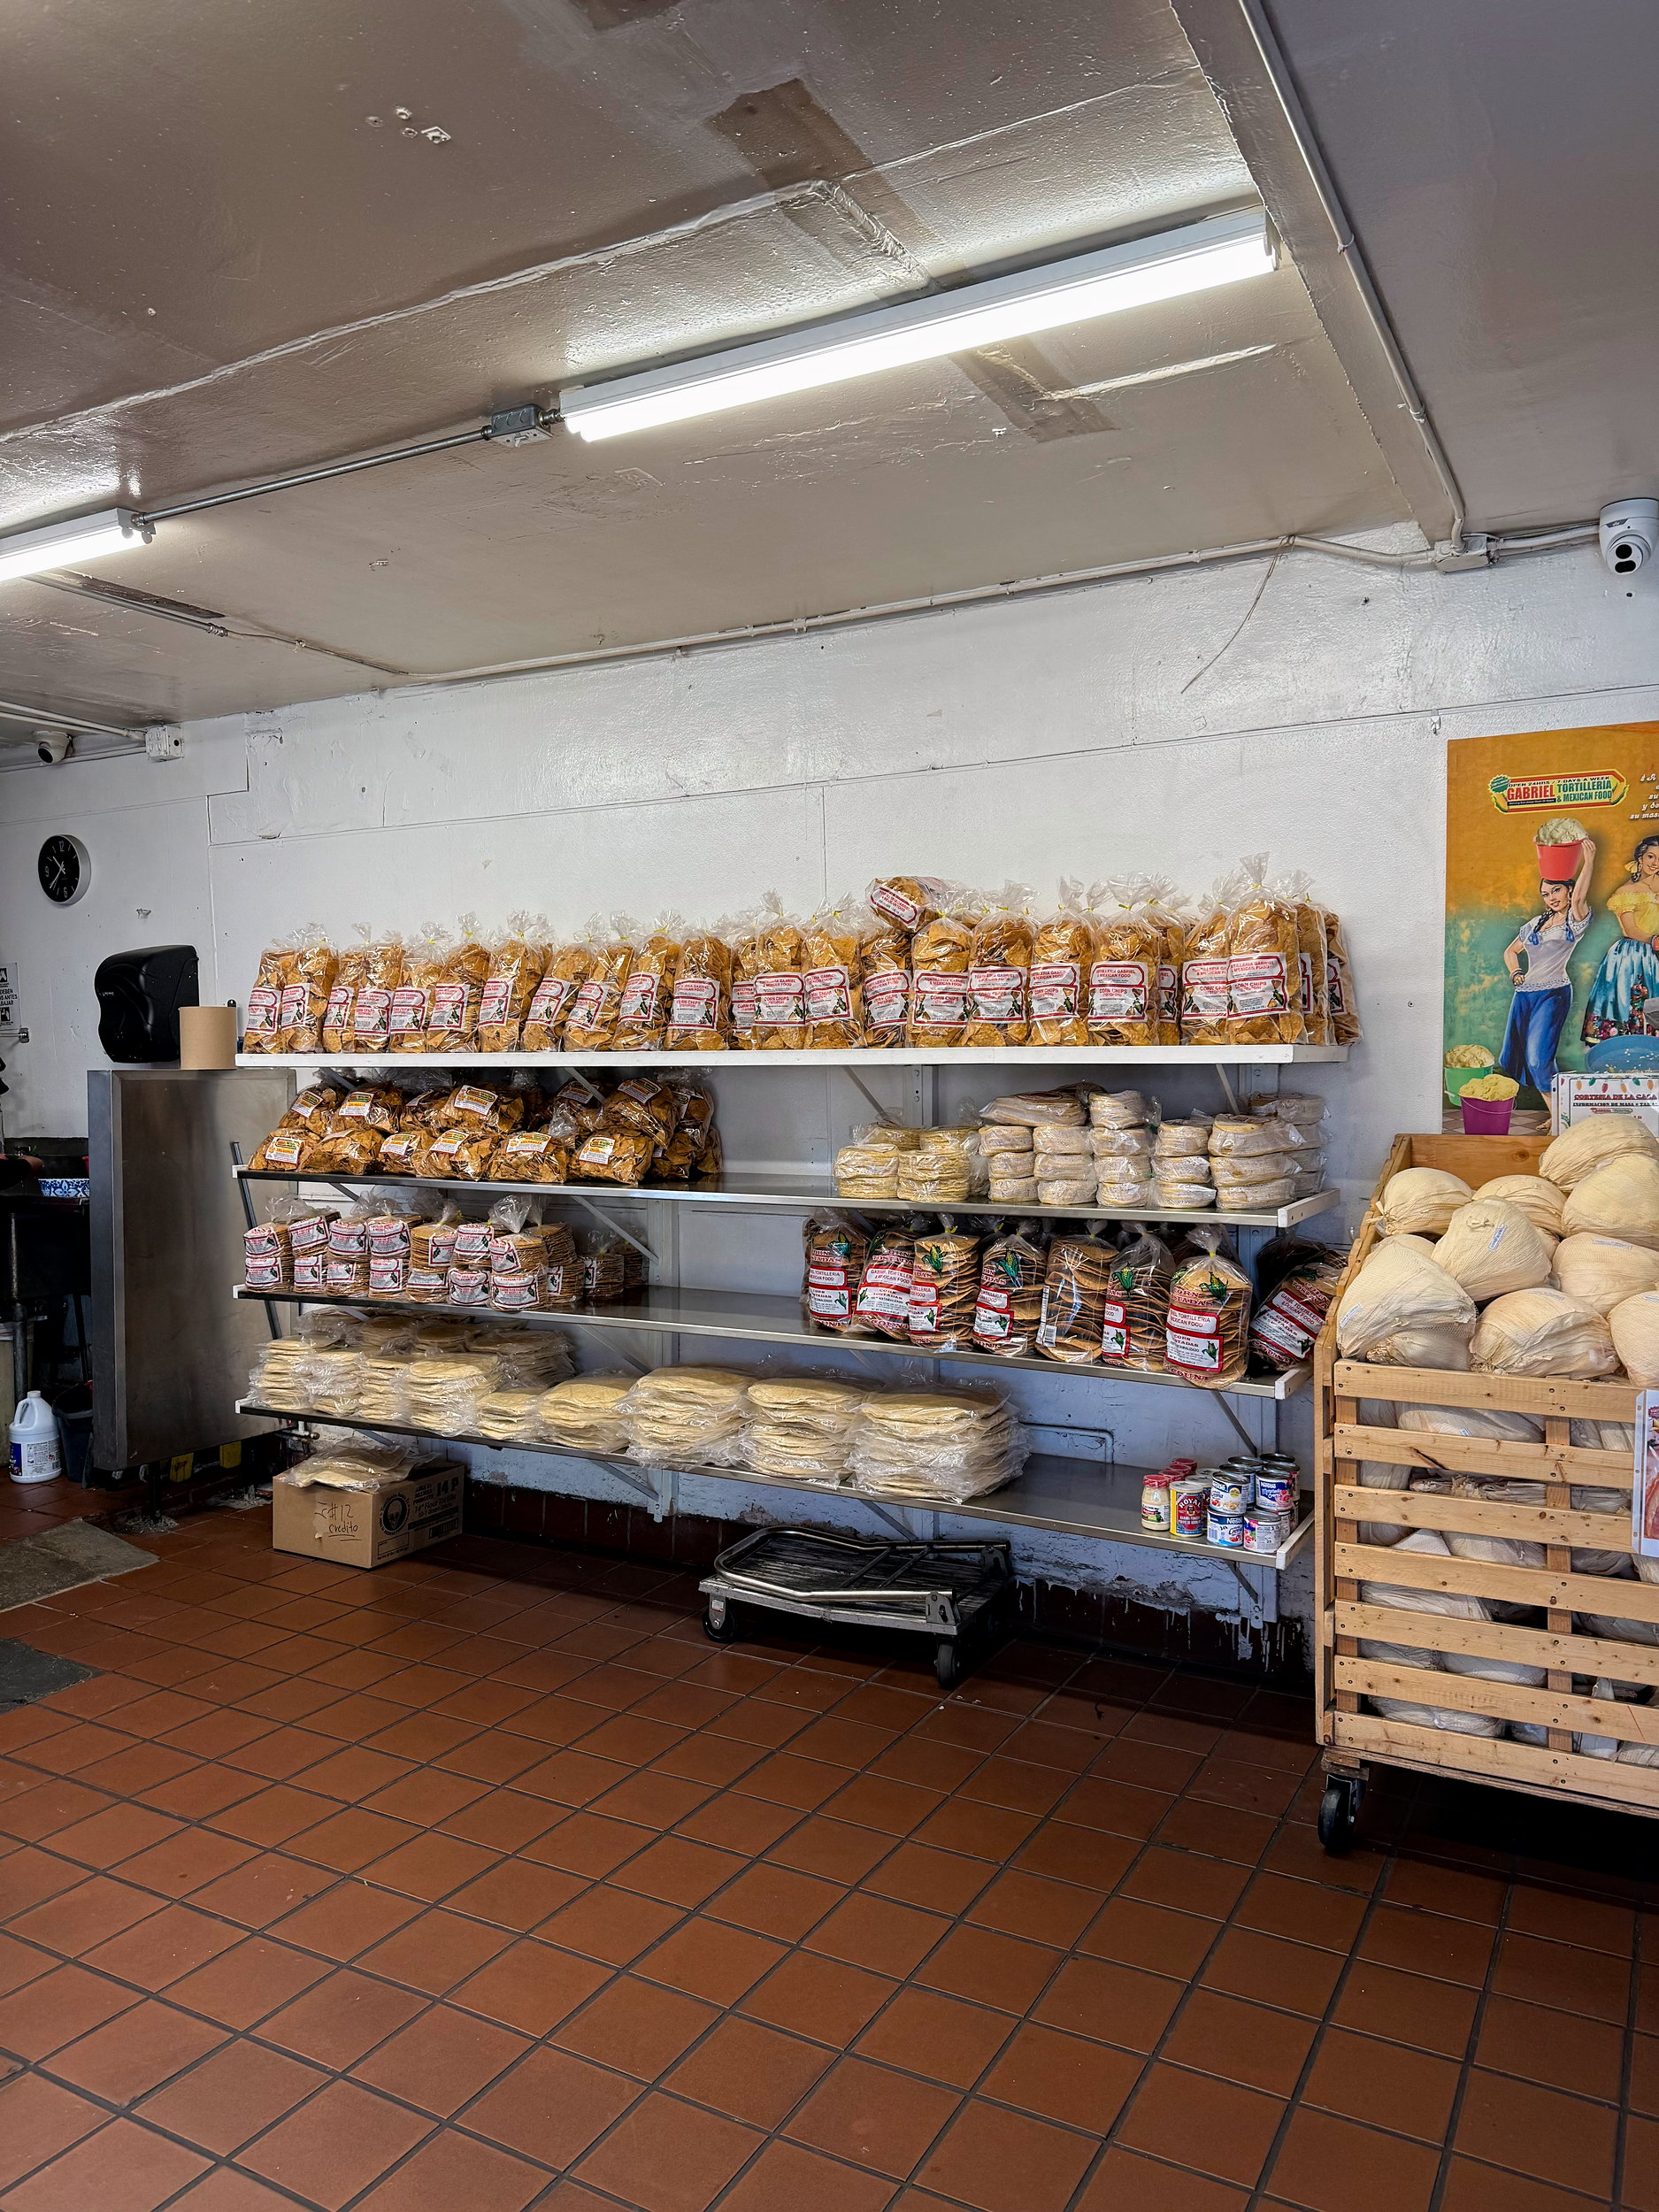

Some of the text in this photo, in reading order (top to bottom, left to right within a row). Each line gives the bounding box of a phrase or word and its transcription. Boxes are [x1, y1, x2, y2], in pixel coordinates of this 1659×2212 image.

[1508, 780, 1611, 801] GABRIEL TORTILLERIA
[1563, 792, 1594, 802] MEXICAN
[1594, 790, 1612, 800] FOOD
[58, 841, 65, 852] 12
[1175, 1288, 1199, 1297] CORN
[1179, 1314, 1210, 1323] TORTILLERIA
[1294, 1302, 1325, 1325] TORTILLERIA
[1301, 1313, 1314, 1325] FOOD
[1266, 1312, 1297, 1335] TOSTADAS
[437, 1480, 448, 1496] 14
[451, 1477, 458, 1491] P
[425, 1501, 438, 1509] Flour
[1179, 1499, 1201, 1509] ROYAL
[329, 1520, 358, 1533] credito
